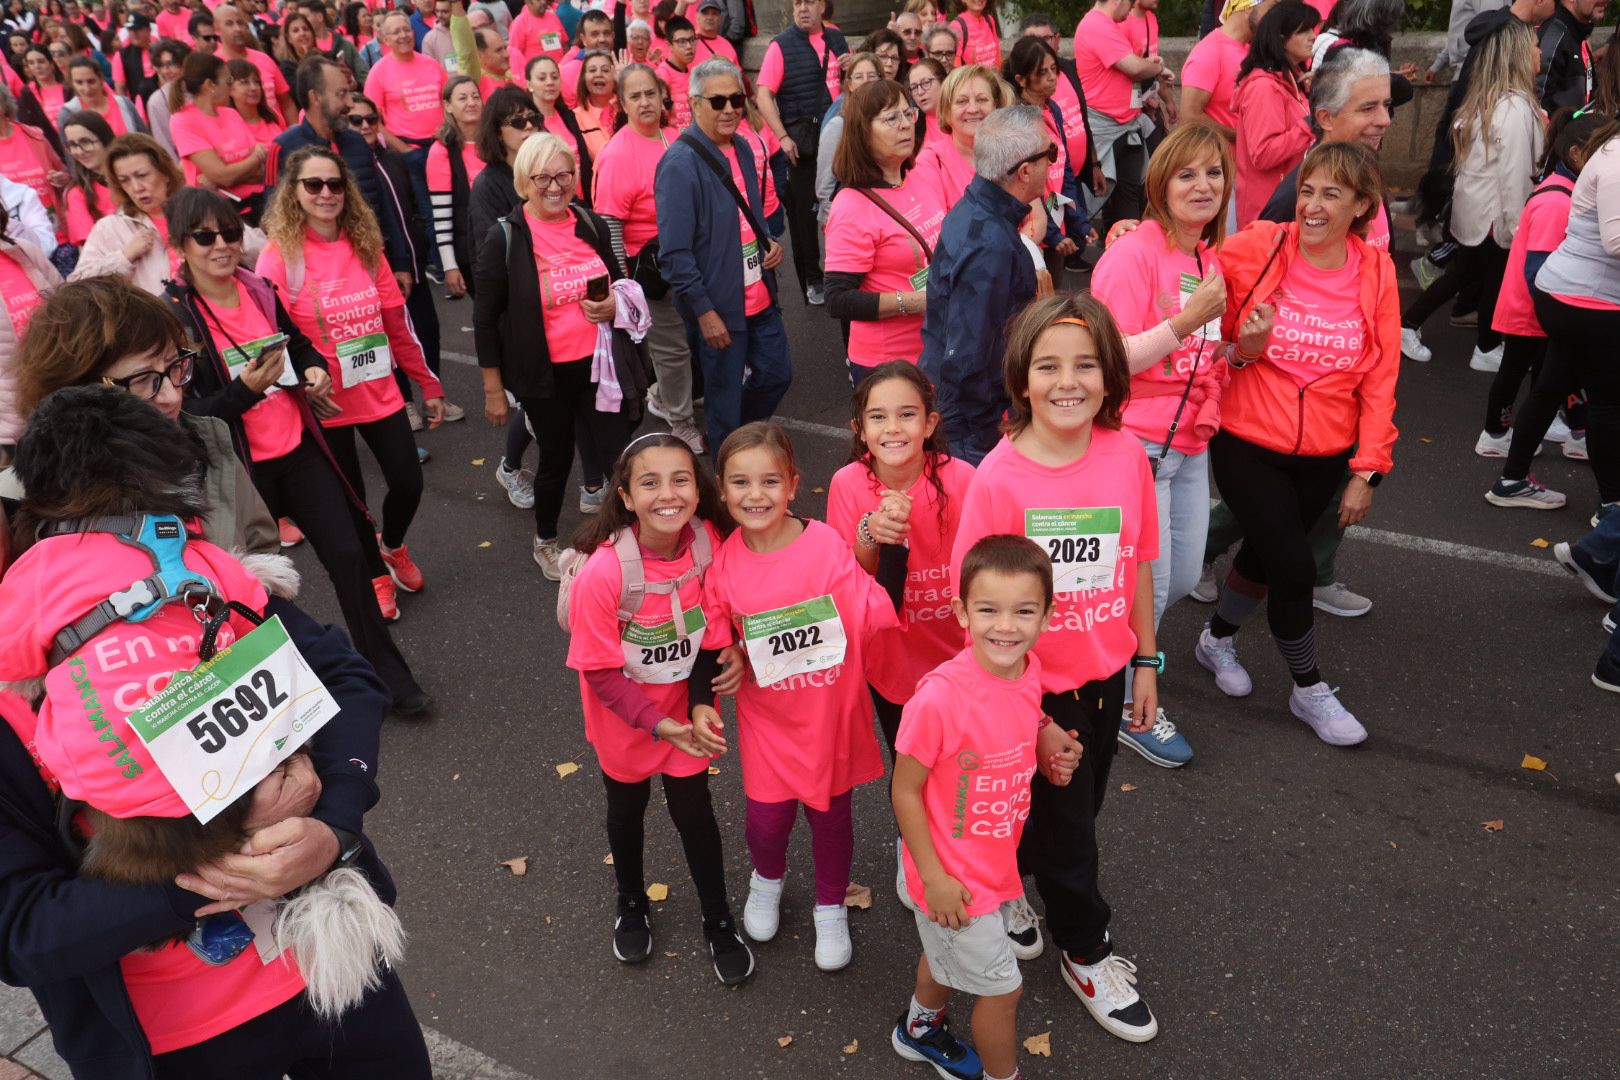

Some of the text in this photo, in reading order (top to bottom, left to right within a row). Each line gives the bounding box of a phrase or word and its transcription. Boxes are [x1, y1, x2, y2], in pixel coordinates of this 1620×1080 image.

[550, 266, 567, 277] En
[322, 296, 339, 308] En
[326, 303, 375, 324] contra
[1279, 306, 1363, 329] En march
[1273, 325, 1345, 349] contra
[352, 350, 376, 369] 2019
[1048, 537, 1100, 563] 2023
[95, 635, 155, 672] En
[641, 638, 691, 665] 2020
[768, 626, 823, 656] 2022
[138, 675, 193, 714] Salamanca
[145, 698, 177, 722] contra
[177, 690, 188, 701] el
[68, 656, 144, 779] SALAMANCA
[186, 669, 288, 754] 5692
[976, 776, 1006, 792] En
